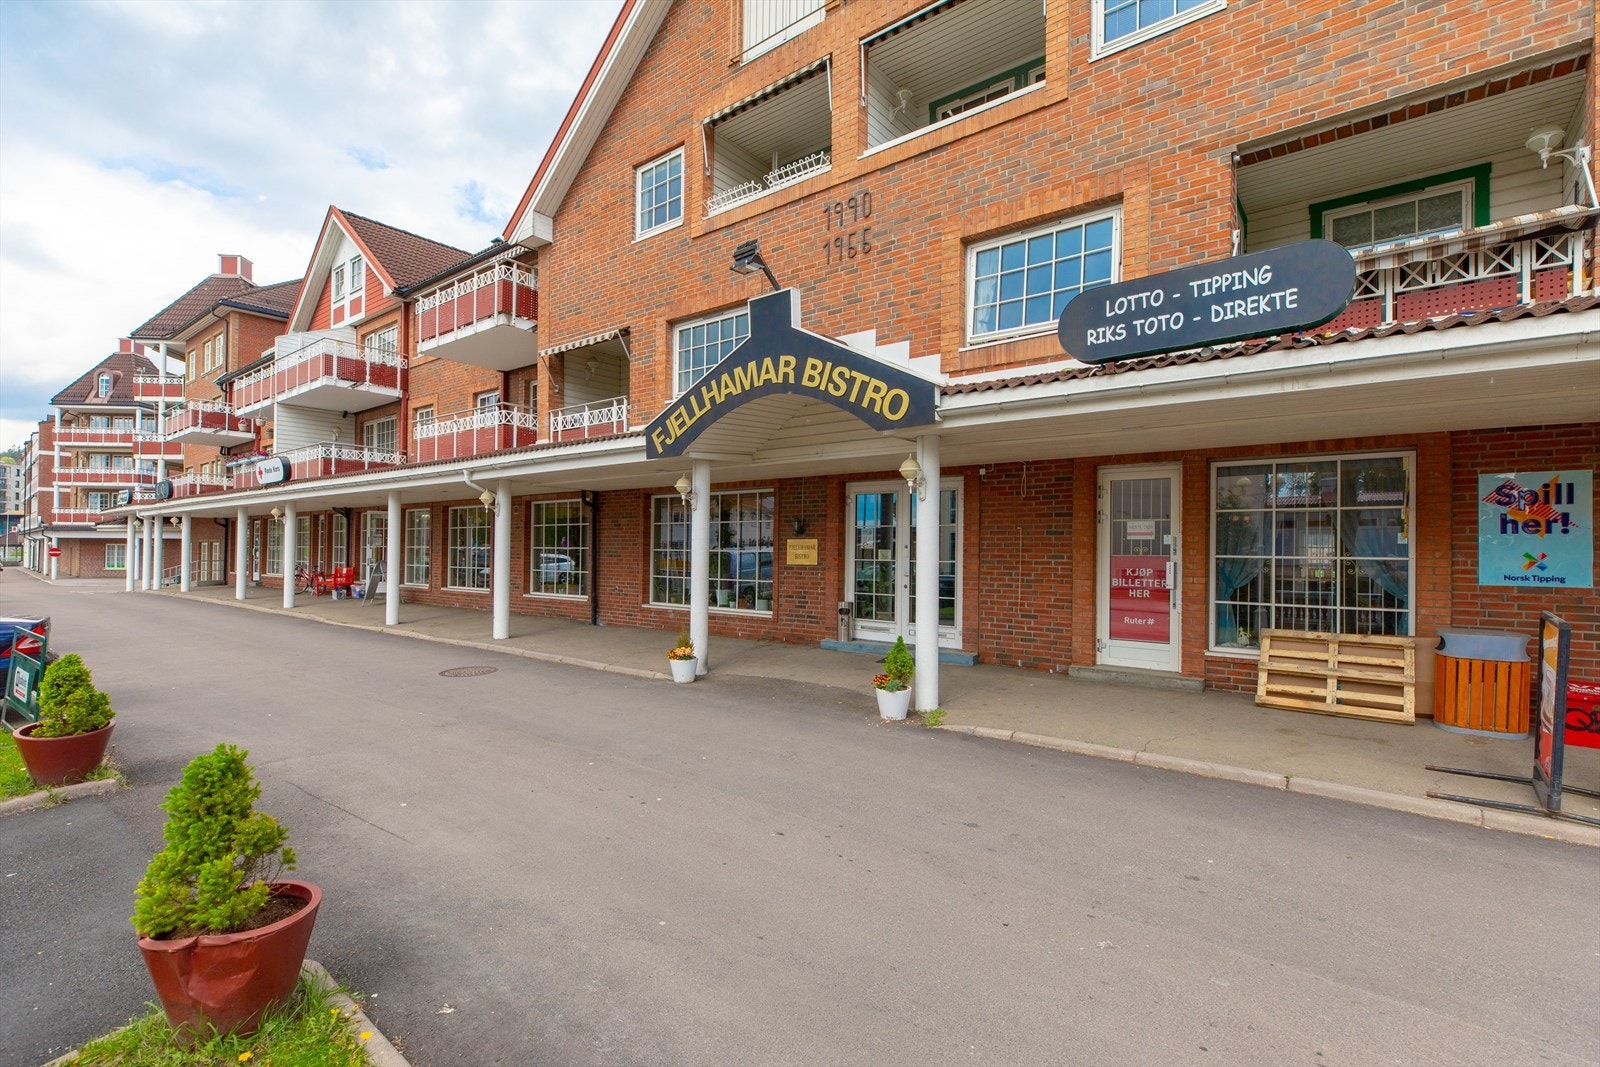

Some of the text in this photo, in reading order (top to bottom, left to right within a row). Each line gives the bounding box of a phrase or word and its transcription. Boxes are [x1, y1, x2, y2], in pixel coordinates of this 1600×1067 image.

[823, 192, 872, 231] 1990
[1105, 289, 1164, 317] LOTTO
[1189, 265, 1273, 298] TIPPING
[1086, 323, 1127, 346] RIKS
[1133, 312, 1184, 337] TOTO
[1211, 288, 1299, 323] DIREKTE
[650, 355, 911, 455] FJELLHAMAR BISTRO
[1494, 482, 1575, 511] Spill
[1499, 512, 1570, 535] her!
[1111, 577, 1167, 588] BILLETTER
[1126, 567, 1154, 577] KJØP
[1503, 574, 1567, 584] Norsk Tipping
[1129, 588, 1151, 598] HER
